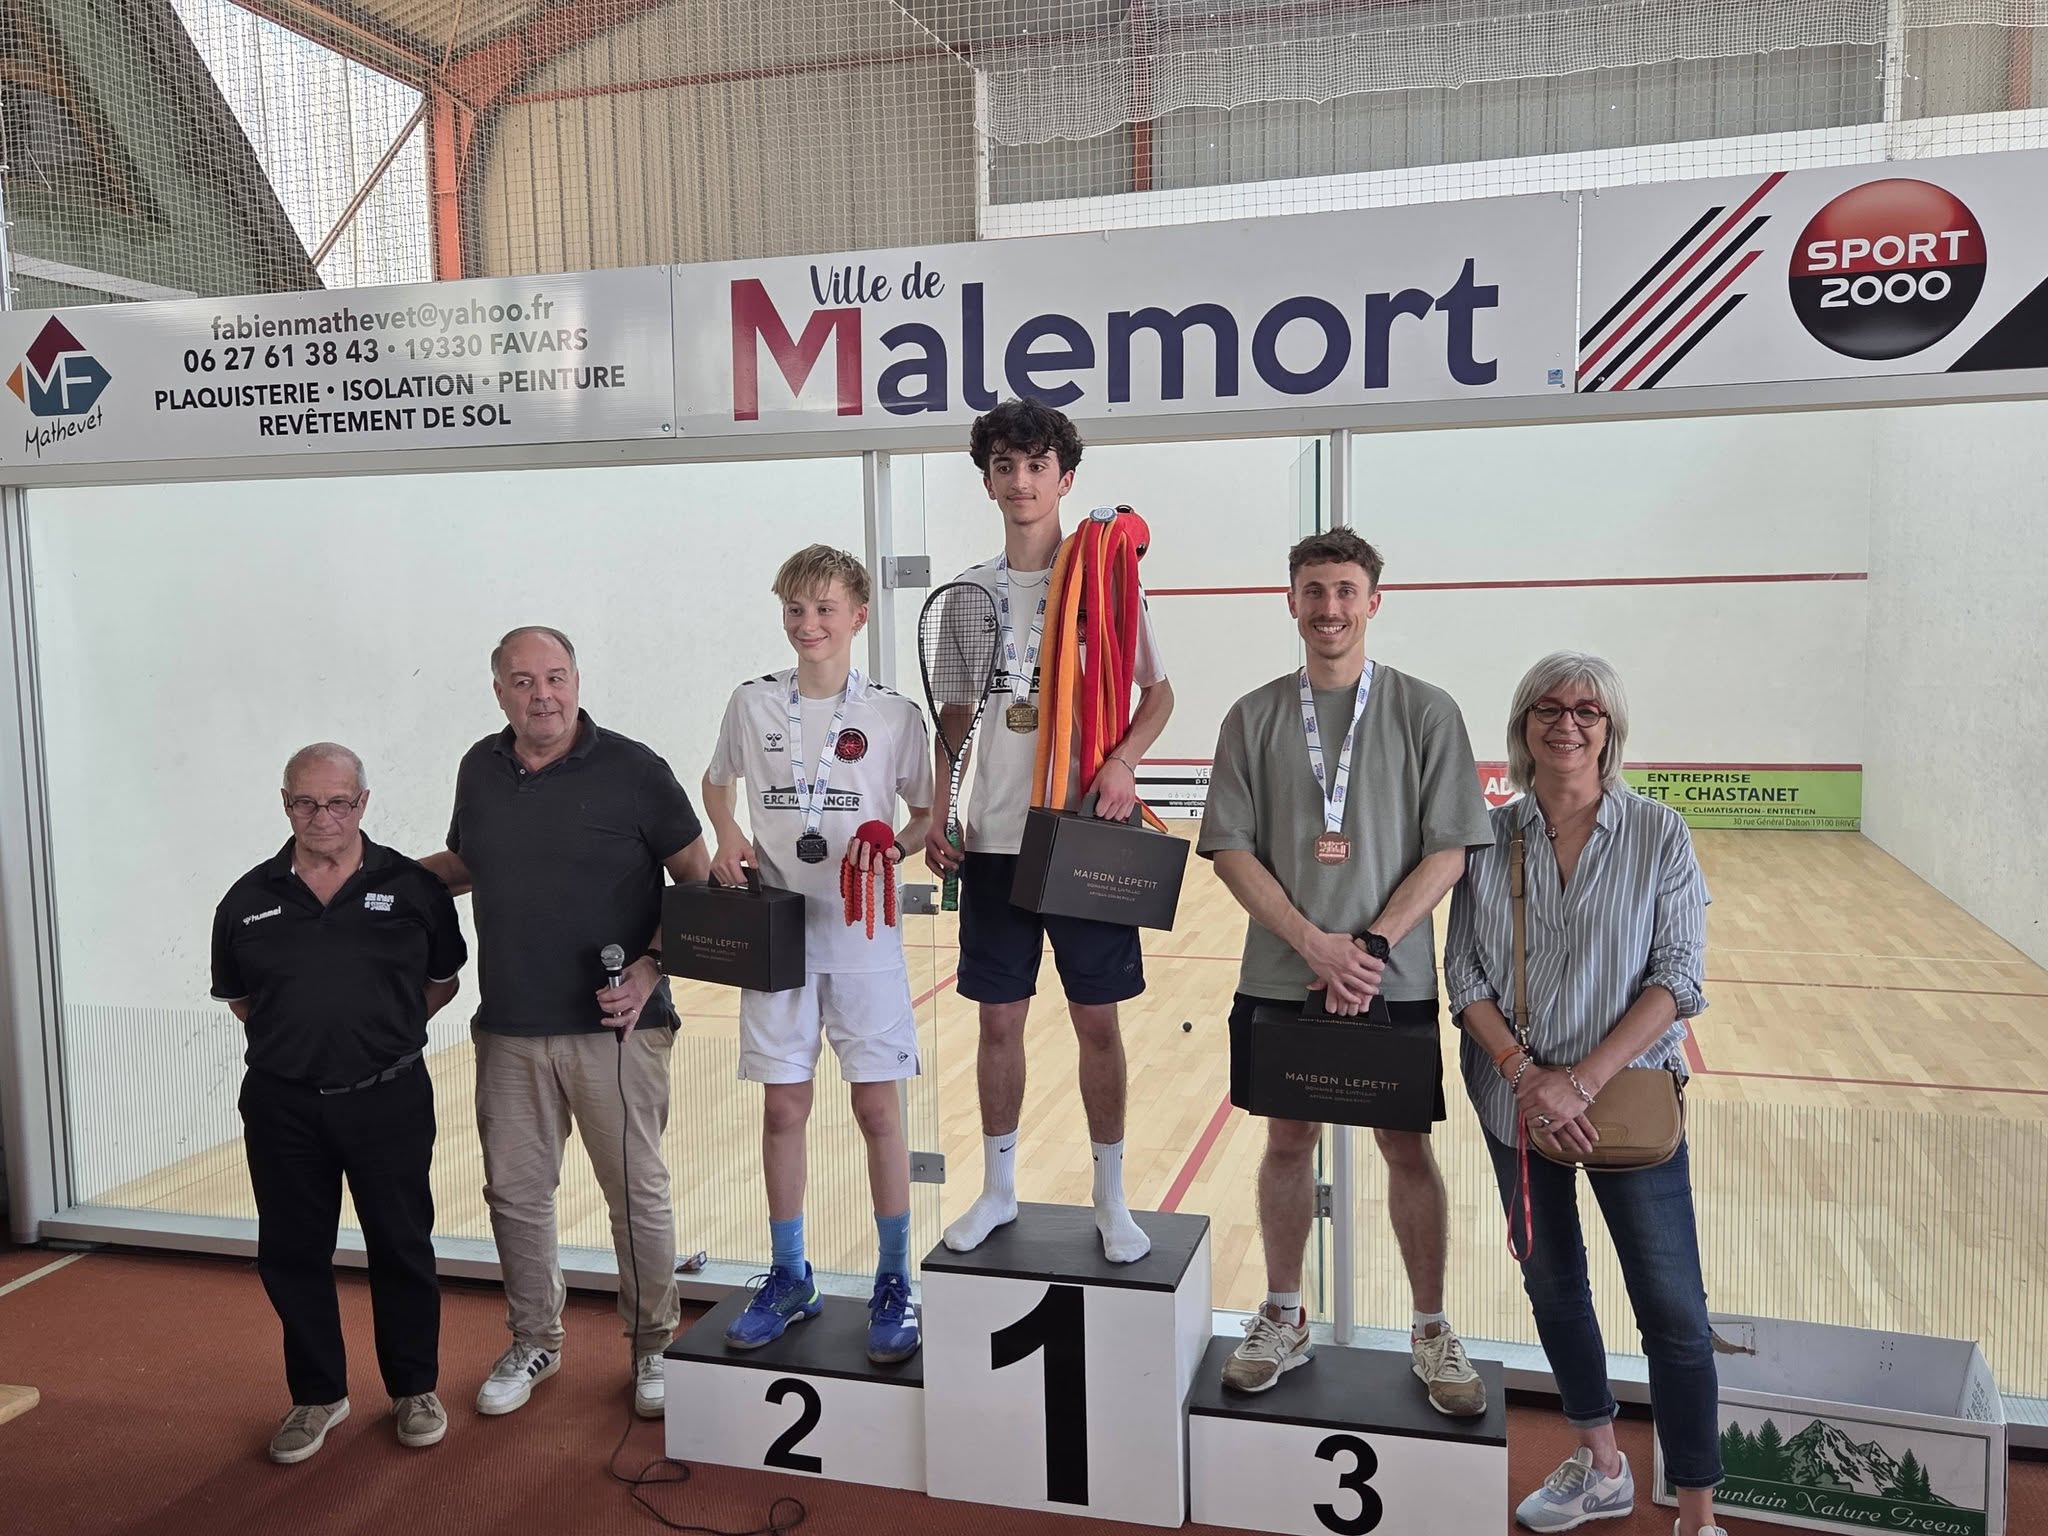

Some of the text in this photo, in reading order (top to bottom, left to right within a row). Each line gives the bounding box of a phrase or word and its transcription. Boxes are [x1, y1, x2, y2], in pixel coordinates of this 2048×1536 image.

[1807, 230, 1969, 272] SPORT
[810, 260, 946, 305] Ville de
[1820, 271, 1952, 309] 2000
[211, 294, 554, 341] fabienmathevet@yahoo.fr
[184, 328, 588, 373] 06 27 61 38 43 19330 FAVARS
[731, 257, 1499, 421] Malemort
[154, 365, 626, 410] PLAQUISTERIE ISOLATION PEINTURE
[25, 404, 103, 458] Mathevet
[259, 403, 511, 436] REVÊTEMENT DE SOL
[1648, 773, 1751, 783] ENTREPRISE
[1685, 787, 1799, 802] CHASTANET
[1693, 806, 1761, 815] CLIMATISATION
[1756, 817, 1785, 826] Général
[1786, 818, 1809, 826] Dalton
[1812, 819, 1834, 827] 19100
[1073, 868, 1158, 890] MAISON LEPETIT
[252, 905, 281, 922] hummel
[681, 933, 749, 950] MAISON LEPETIT
[1285, 1071, 1399, 1091] MAISON LEPETIT
[990, 1285, 1089, 1507] 1
[763, 1378, 824, 1474] 2
[1313, 1434, 1383, 1536] 3
[1796, 1492, 1881, 1522] Nature
[1891, 1507, 1971, 1536] Greens
